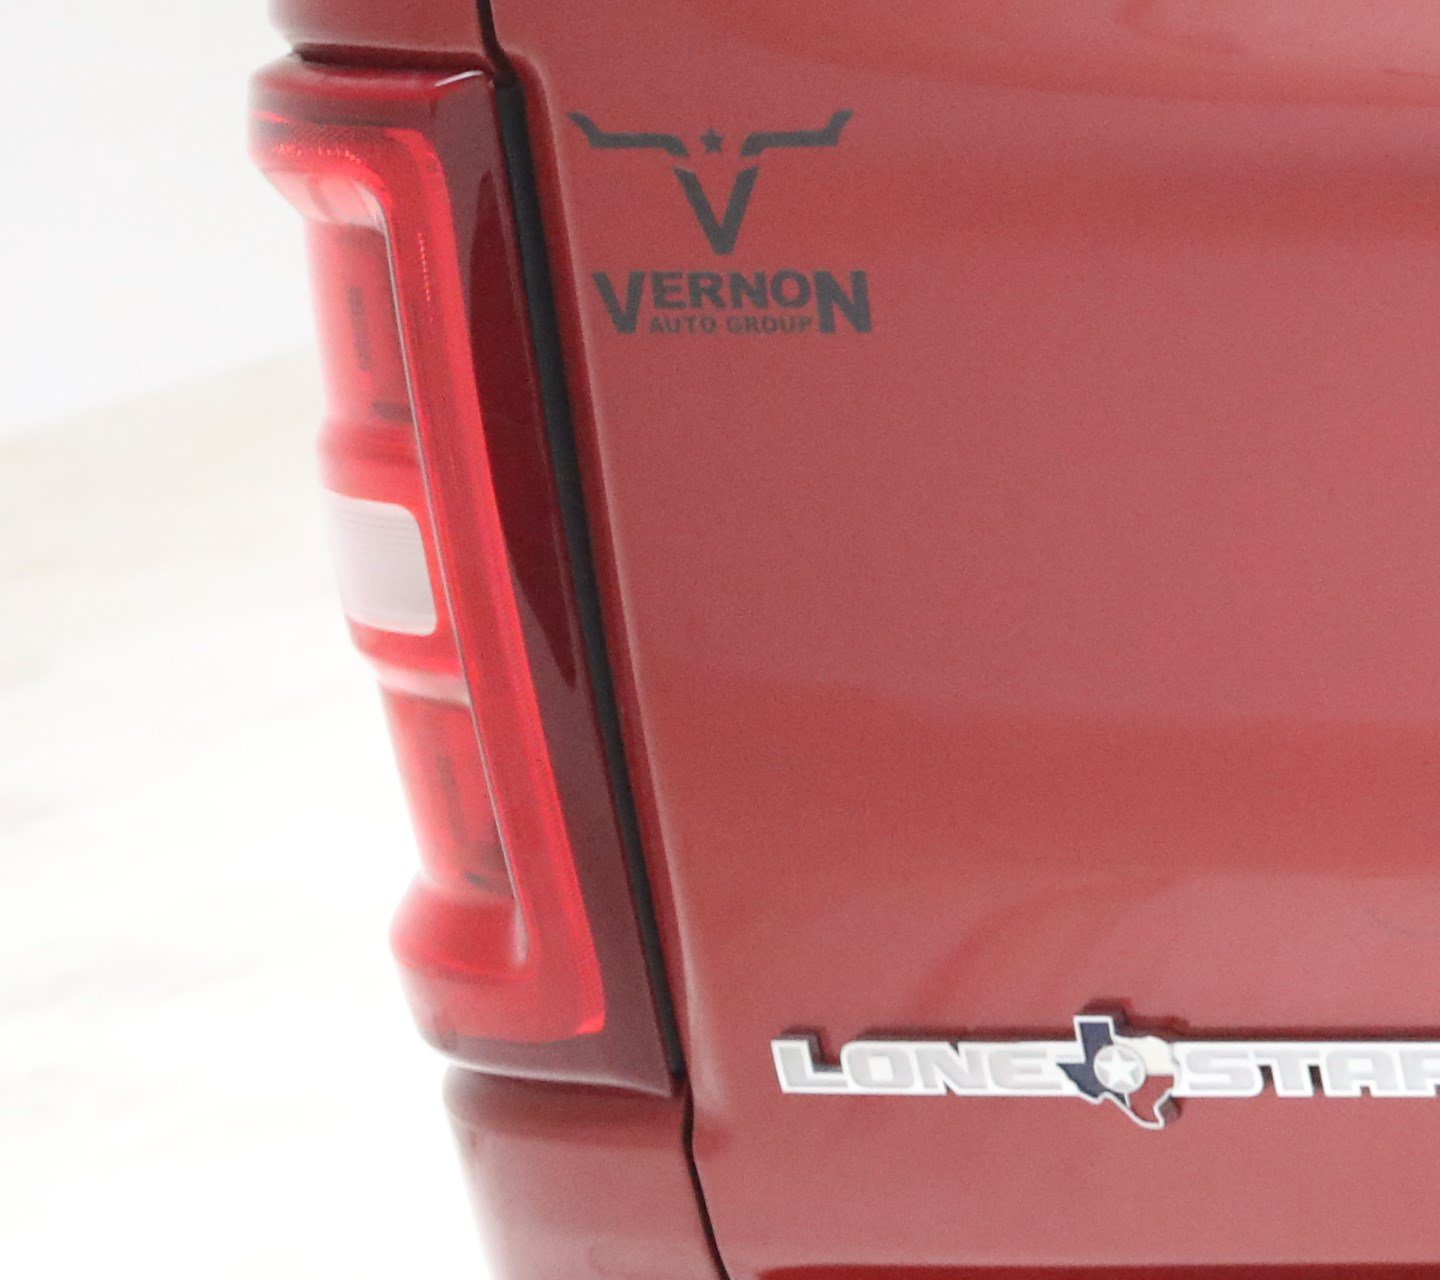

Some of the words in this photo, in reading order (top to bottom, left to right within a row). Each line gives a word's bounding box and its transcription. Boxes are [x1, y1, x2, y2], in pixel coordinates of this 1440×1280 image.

[592, 269, 872, 335] VERNON
[651, 316, 718, 334] AUTO
[726, 316, 811, 333] GROUP
[770, 1037, 1062, 1095] LONE
